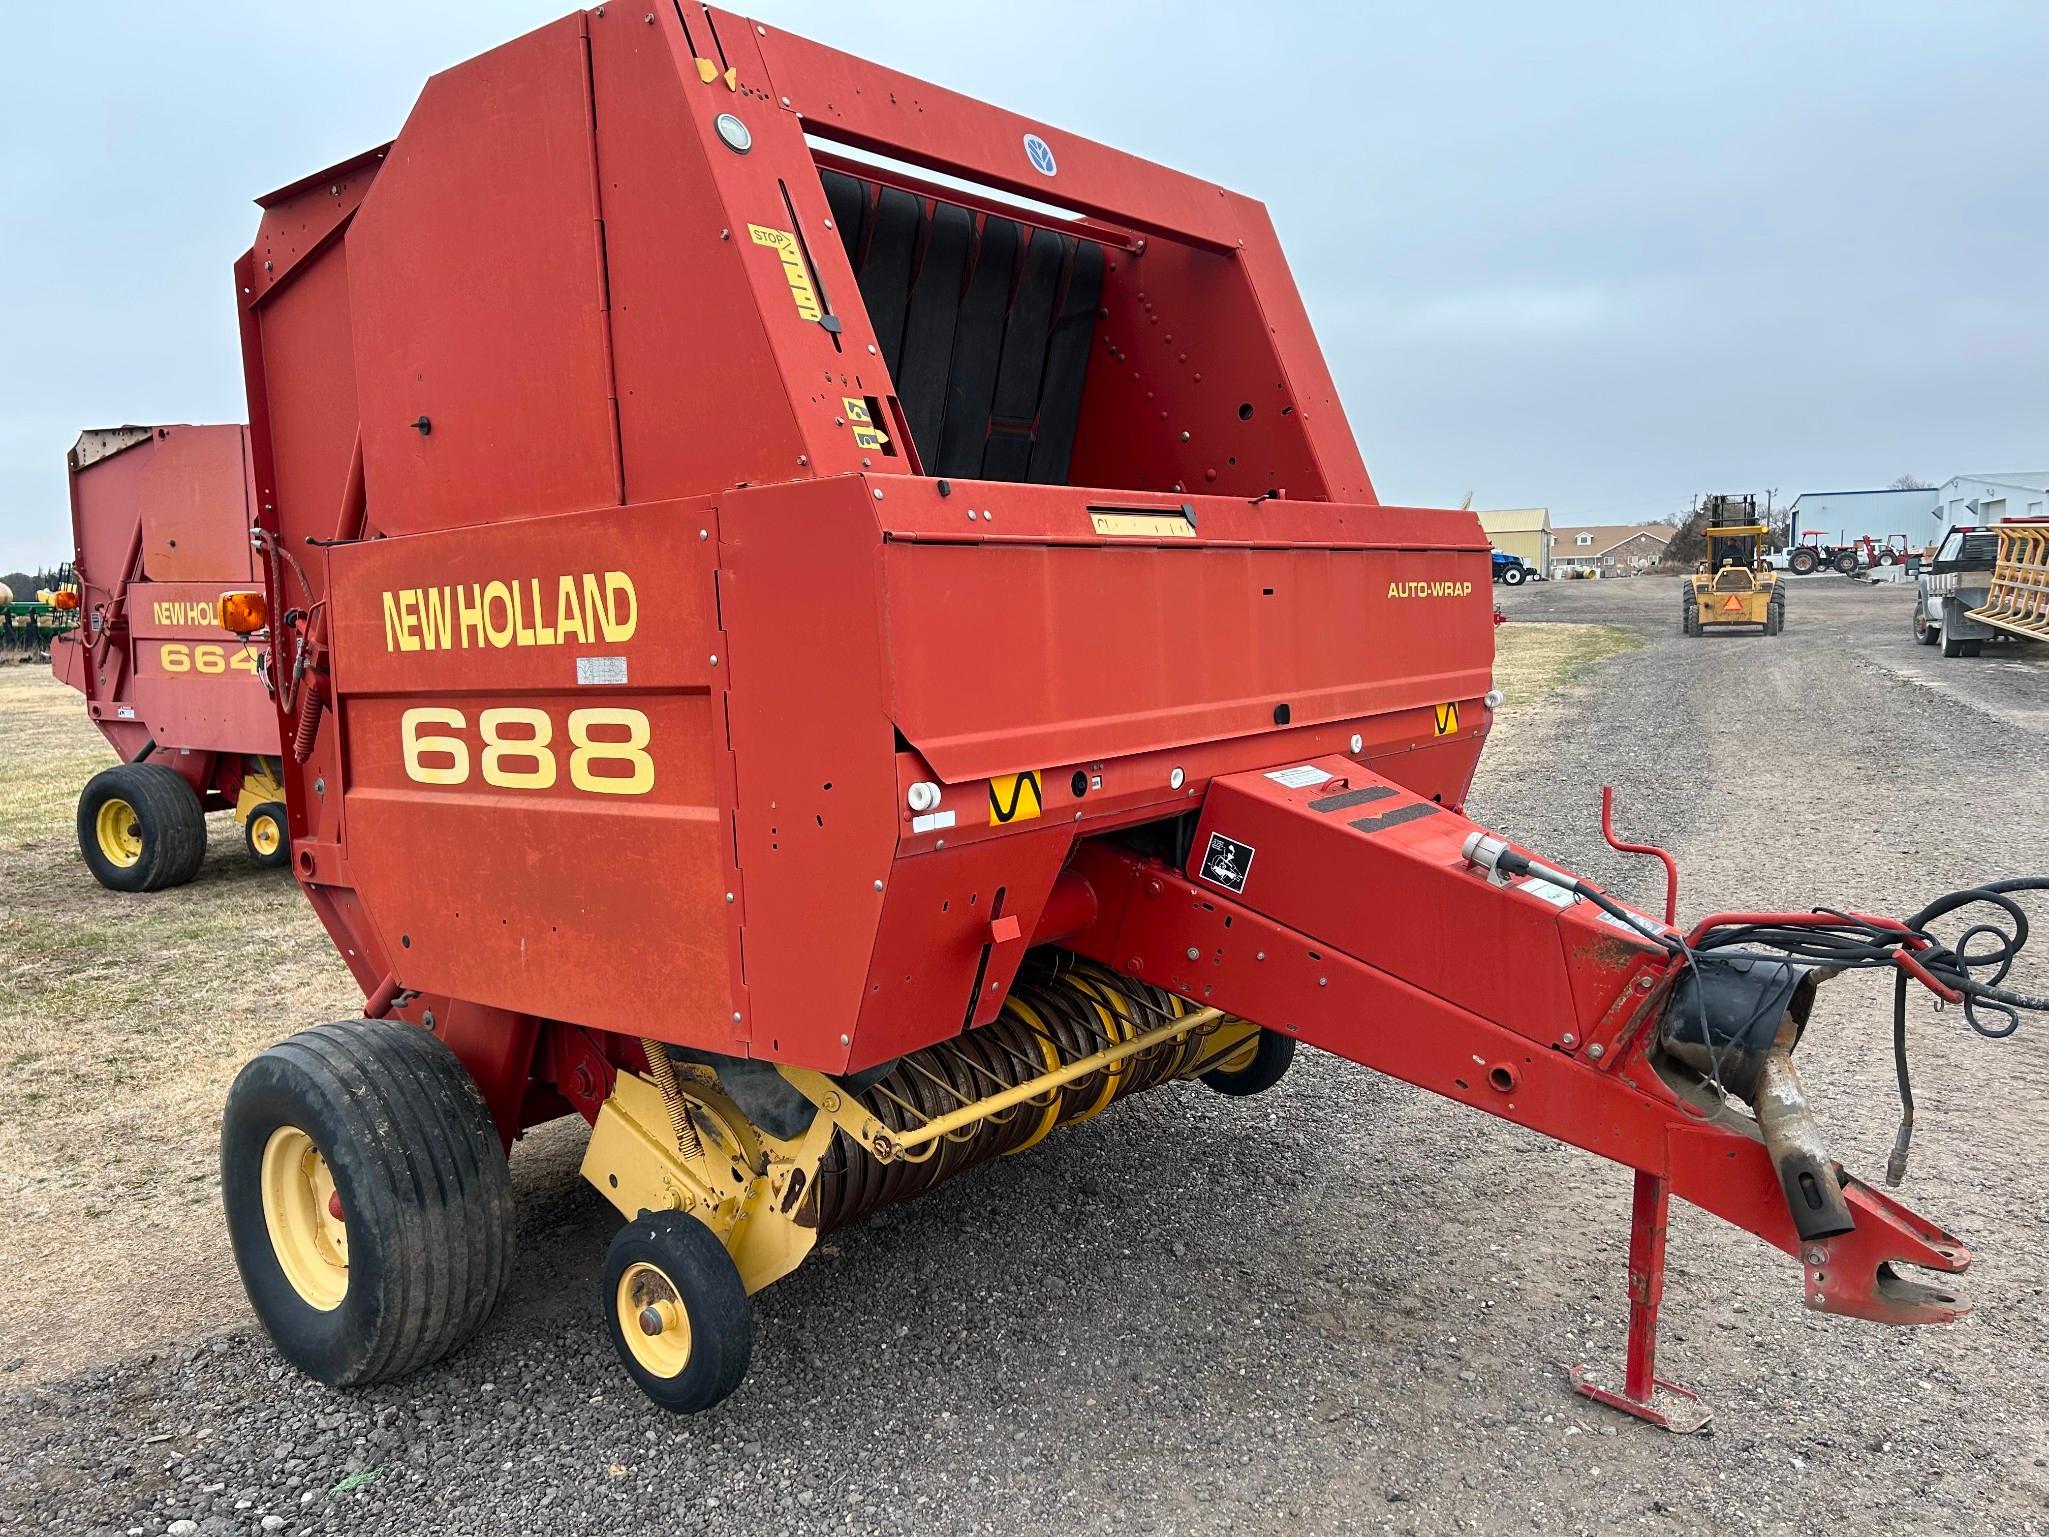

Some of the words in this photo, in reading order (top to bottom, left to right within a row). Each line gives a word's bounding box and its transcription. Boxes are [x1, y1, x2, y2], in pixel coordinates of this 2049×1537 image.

[754, 230, 784, 244] STOP
[1388, 581, 1472, 598] AUTO-WRAP
[153, 602, 185, 625] NEW
[382, 586, 453, 651] NEW
[456, 571, 637, 648] HOLLAND
[160, 643, 258, 675] 664
[401, 707, 654, 795] 688
